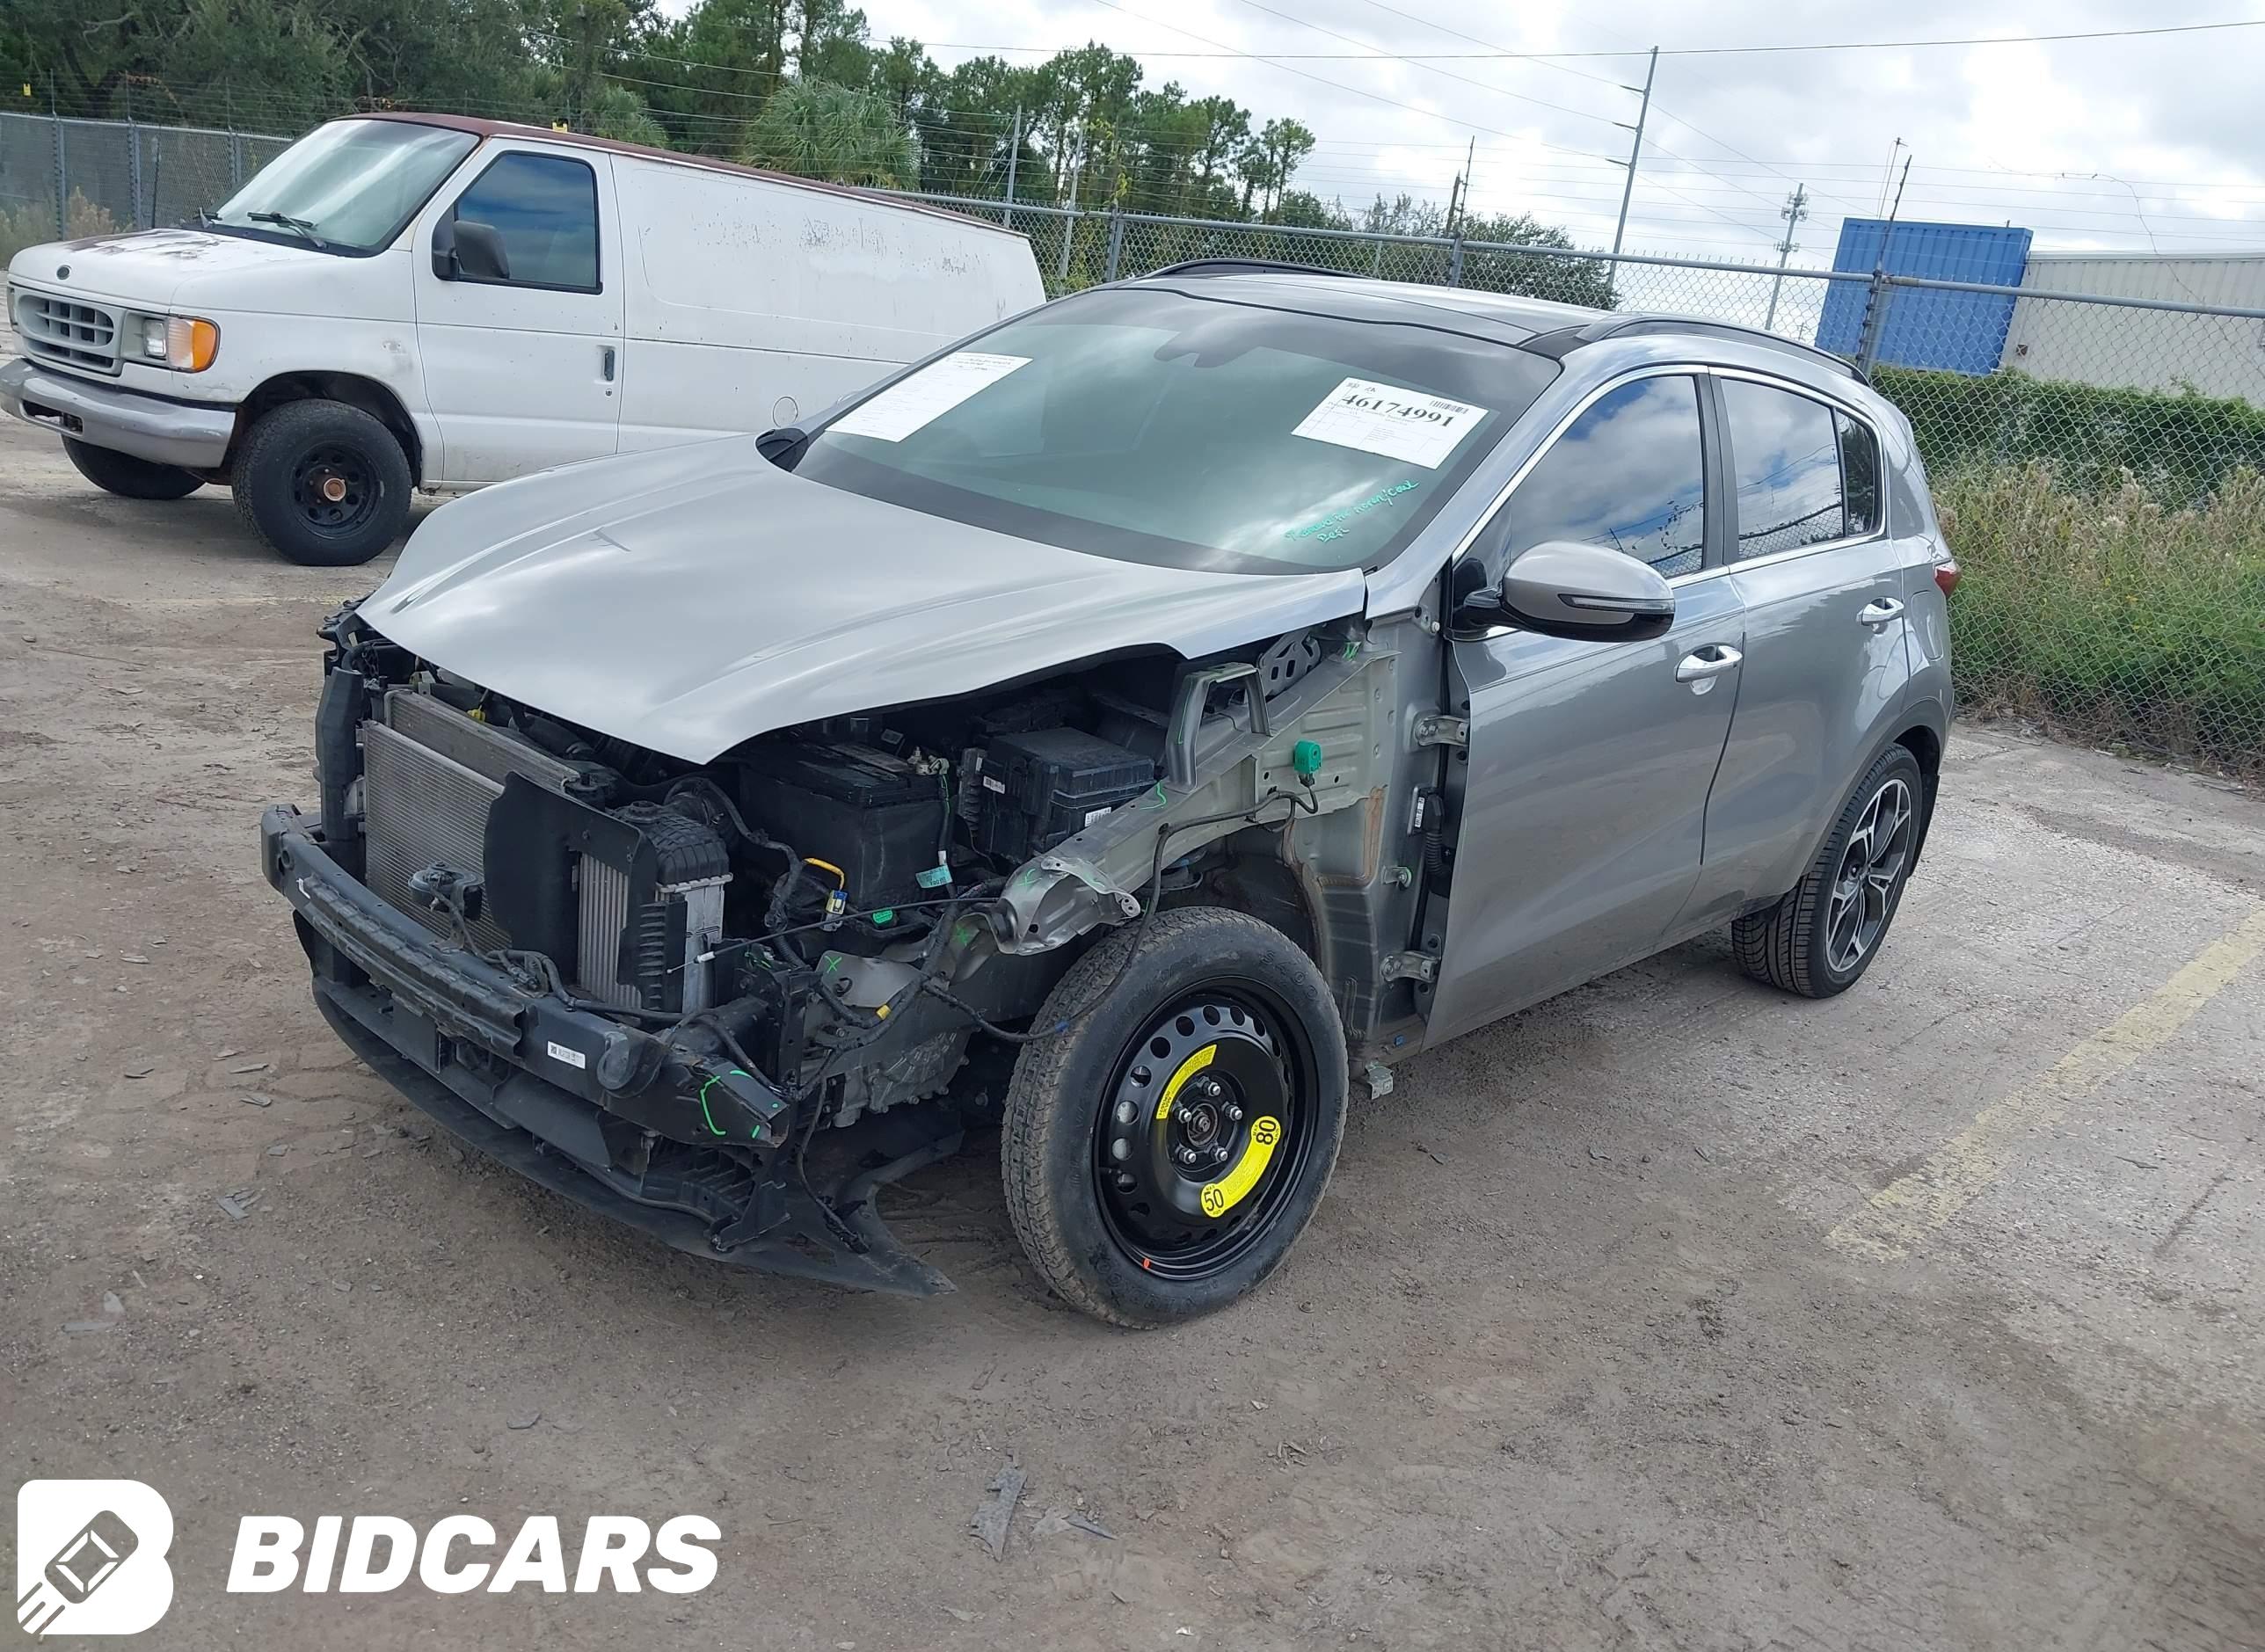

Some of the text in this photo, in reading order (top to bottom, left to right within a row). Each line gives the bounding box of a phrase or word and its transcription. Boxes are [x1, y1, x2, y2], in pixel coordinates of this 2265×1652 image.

[1341, 394, 1455, 427] 46174991
[1256, 1119, 1276, 1145] 80
[1204, 1188, 1224, 1212] 50
